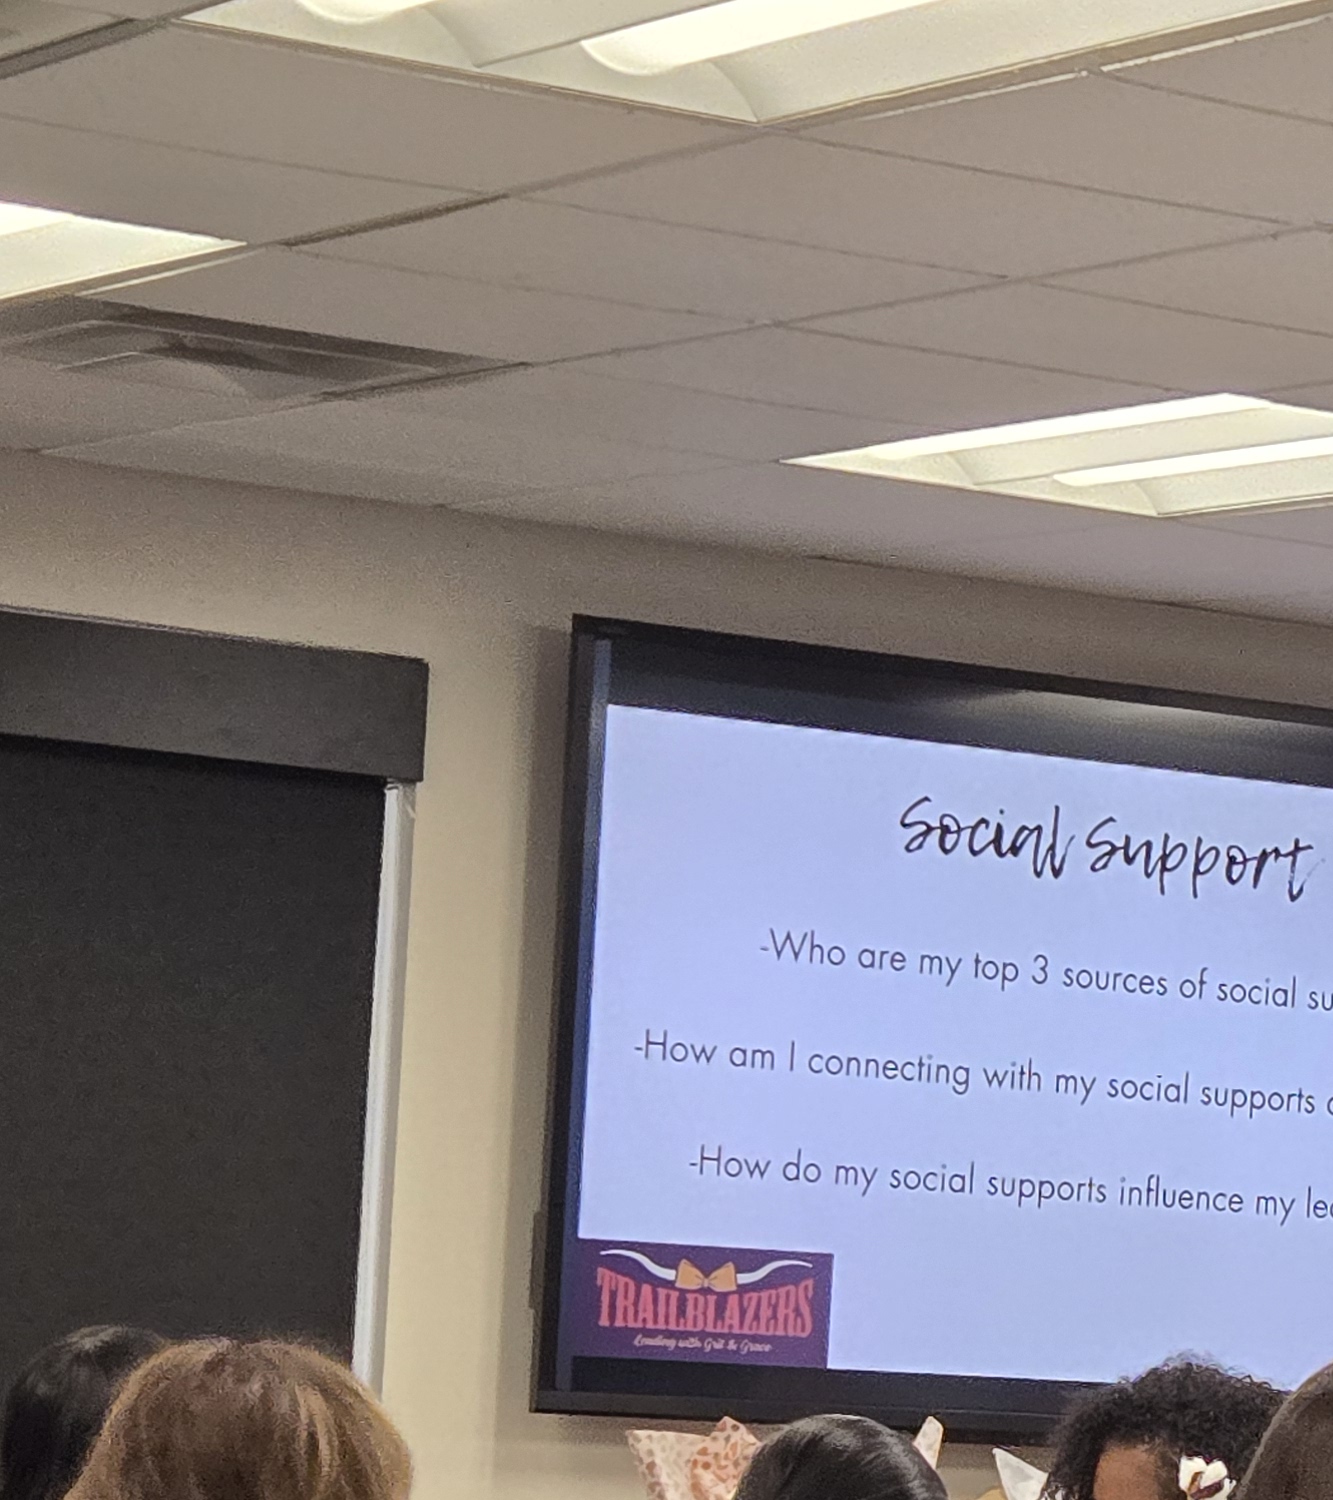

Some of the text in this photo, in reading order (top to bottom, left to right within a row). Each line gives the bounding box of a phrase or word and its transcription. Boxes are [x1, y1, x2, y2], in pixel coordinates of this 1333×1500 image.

[900, 796, 1326, 902] Social Support
[760, 927, 846, 966] -Who
[858, 948, 907, 972] are
[919, 953, 962, 987] my
[974, 952, 1019, 991] top
[1031, 954, 1049, 984] 3
[1062, 966, 1168, 996] sources
[1179, 967, 1209, 1000] of
[1216, 975, 1297, 1008] social
[634, 1028, 718, 1064] -How
[728, 1047, 775, 1071] am
[789, 1040, 796, 1071] I
[808, 1053, 970, 1095] connecting
[983, 1058, 1042, 1092] with
[1055, 1073, 1097, 1106] my
[1107, 1071, 1190, 1104] social
[1200, 1086, 1316, 1119] supports
[689, 1144, 772, 1180] -How
[782, 1148, 822, 1183] do
[834, 1164, 878, 1197] my
[889, 1161, 975, 1195] social
[986, 1175, 1107, 1209] supports
[1119, 1174, 1244, 1213] influence
[1255, 1195, 1296, 1227] my
[596, 1266, 815, 1339] TRAILBLAZERS
